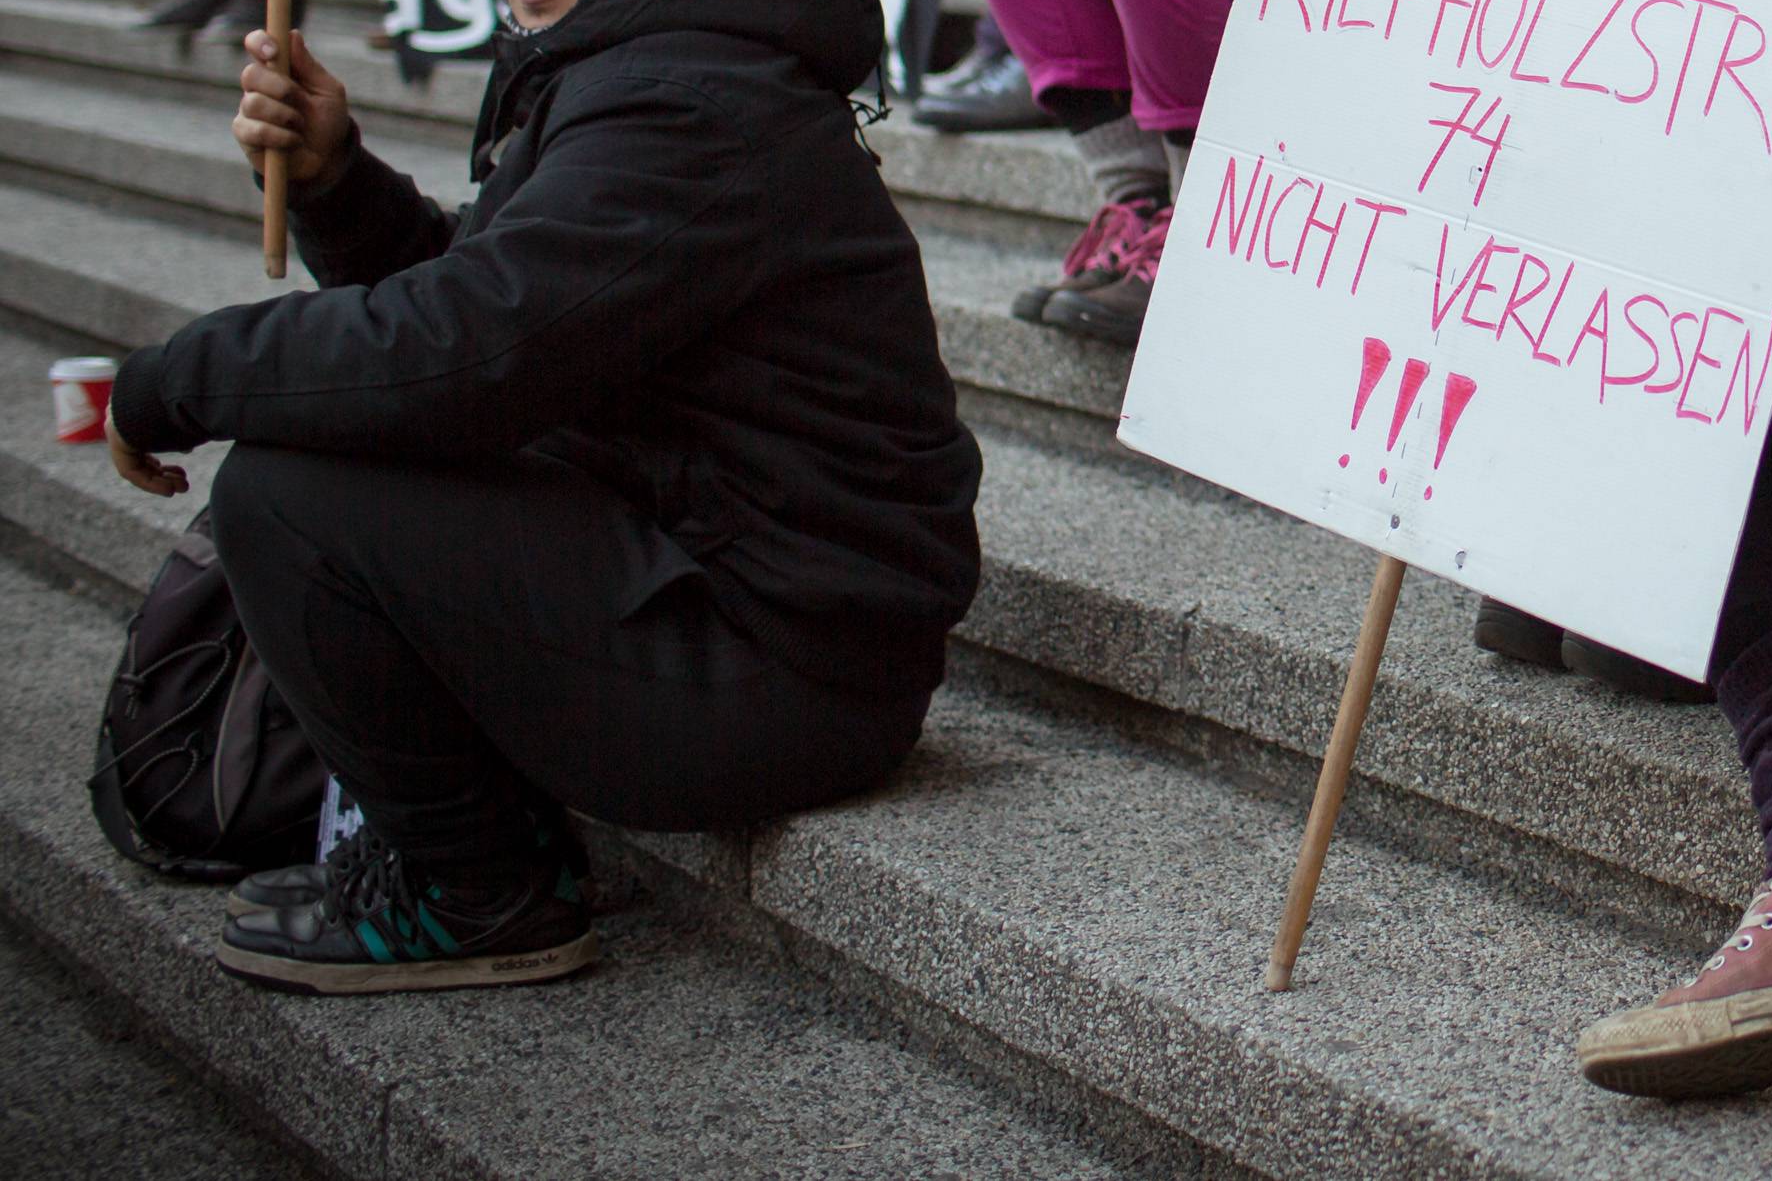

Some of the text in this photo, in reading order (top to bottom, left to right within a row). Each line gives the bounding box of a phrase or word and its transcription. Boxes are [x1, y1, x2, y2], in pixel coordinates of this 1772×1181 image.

[1205, 141, 1408, 295] NICHT
[1418, 82, 1511, 206] 74
[1337, 336, 1477, 501] !!!
